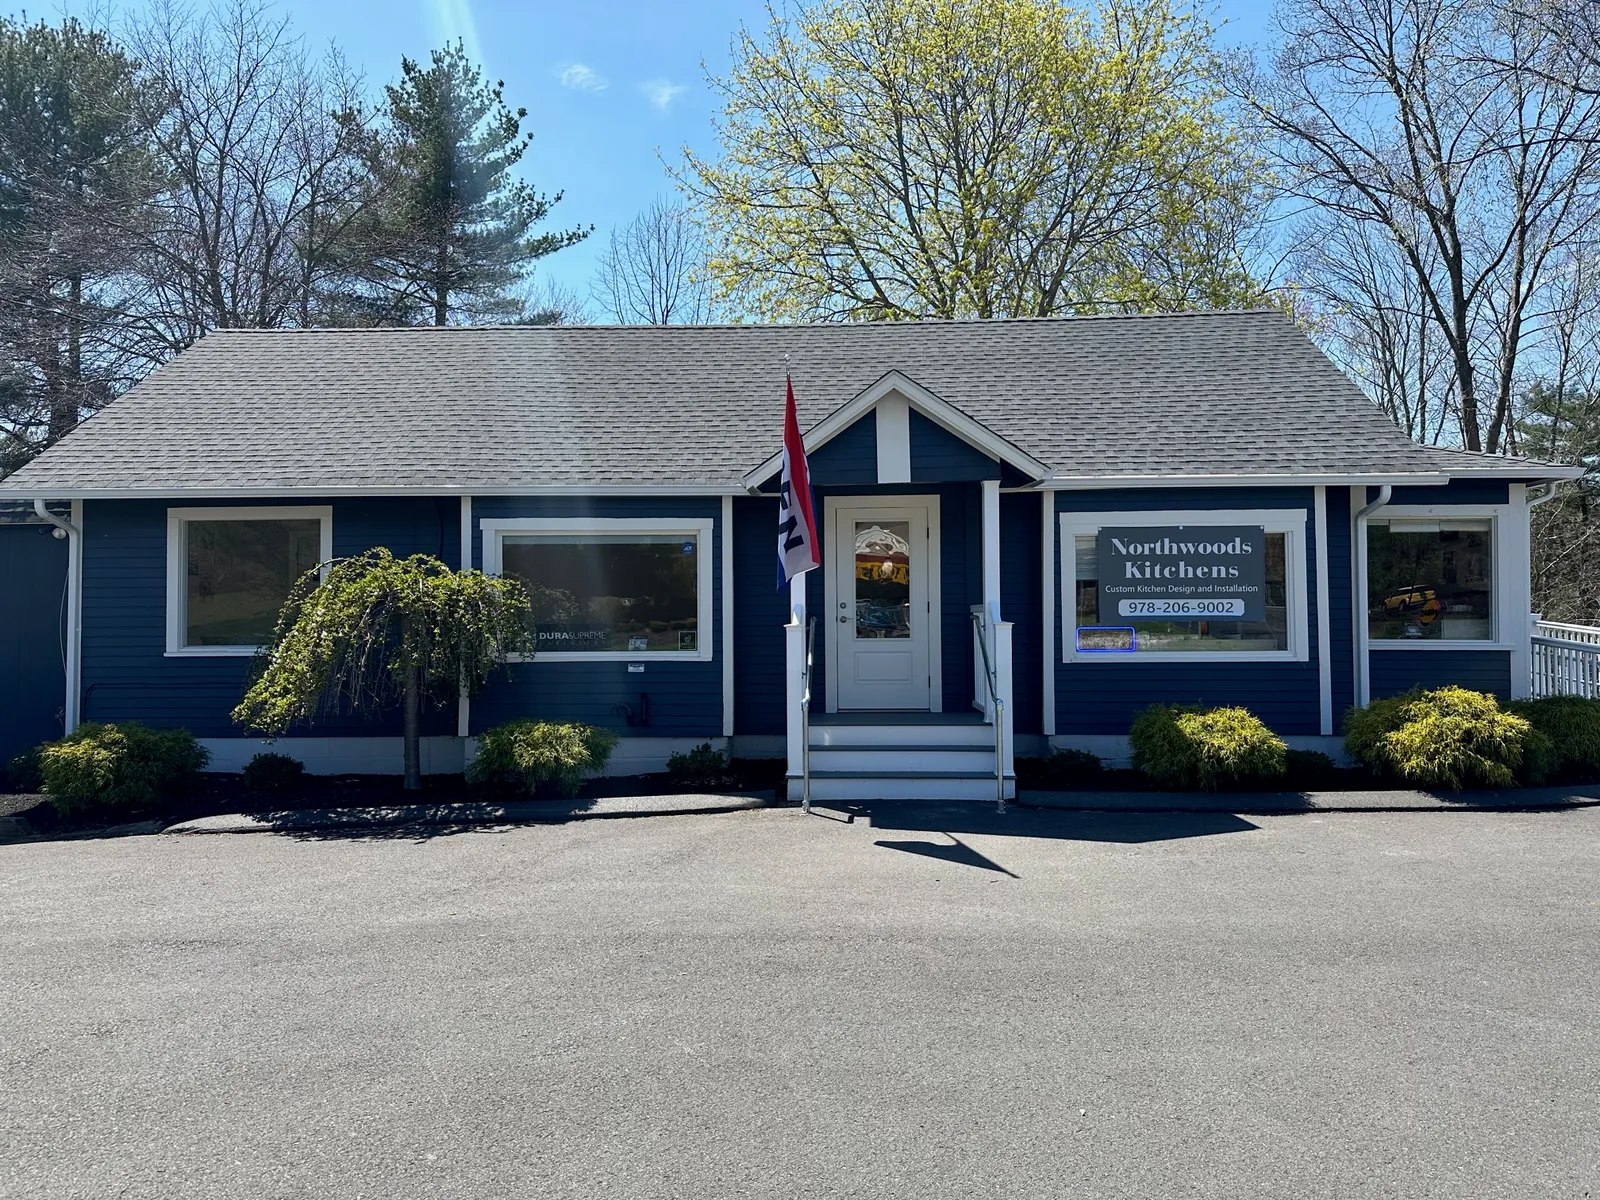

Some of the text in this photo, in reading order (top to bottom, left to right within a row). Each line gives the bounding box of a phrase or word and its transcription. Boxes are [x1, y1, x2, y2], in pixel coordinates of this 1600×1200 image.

[1110, 537, 1252, 556] Northwoods
[1124, 560, 1239, 579] Kitchens
[1105, 584, 1259, 595] Custom Kitchen Design and Installation
[1128, 601, 1234, 614] 978-206-9002
